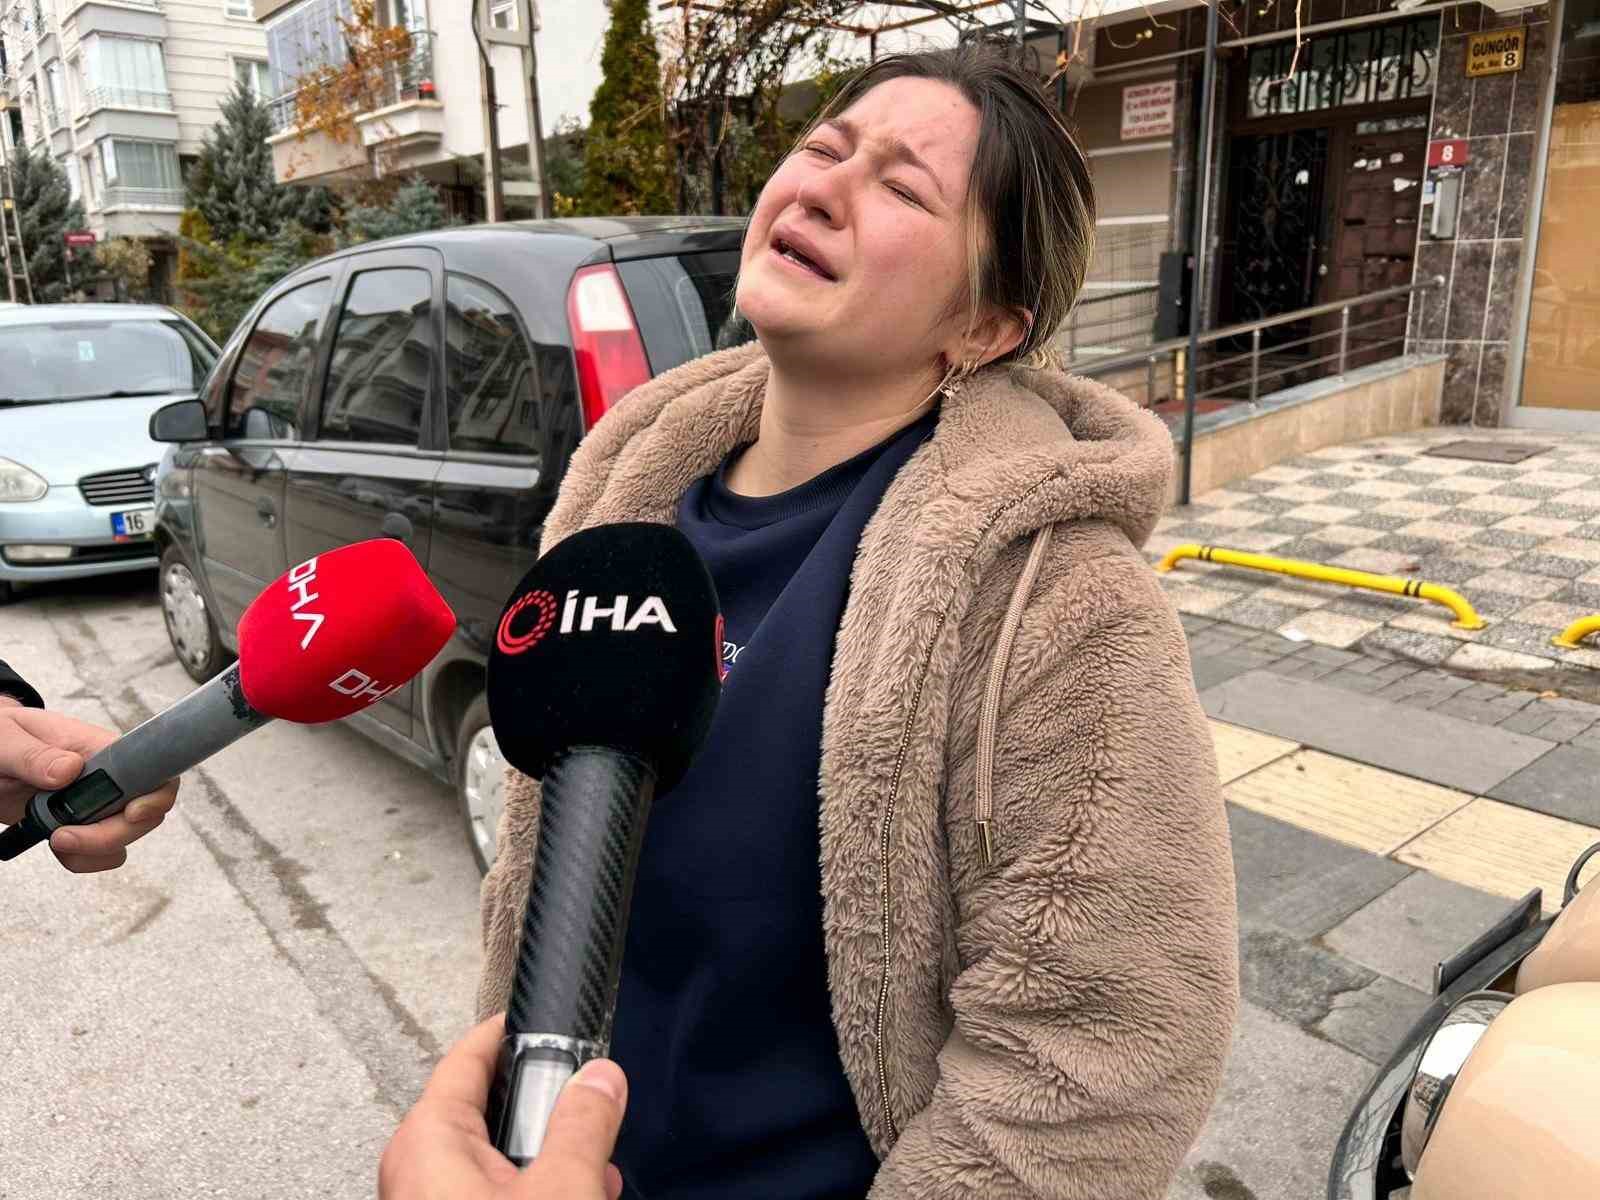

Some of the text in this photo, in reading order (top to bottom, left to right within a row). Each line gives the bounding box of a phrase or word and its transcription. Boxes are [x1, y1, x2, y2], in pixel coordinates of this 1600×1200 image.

[1503, 52, 1516, 67] 8
[1441, 144, 1453, 162] 8
[126, 512, 145, 531] 16
[559, 589, 678, 635] İHA
[328, 668, 404, 703] DH
